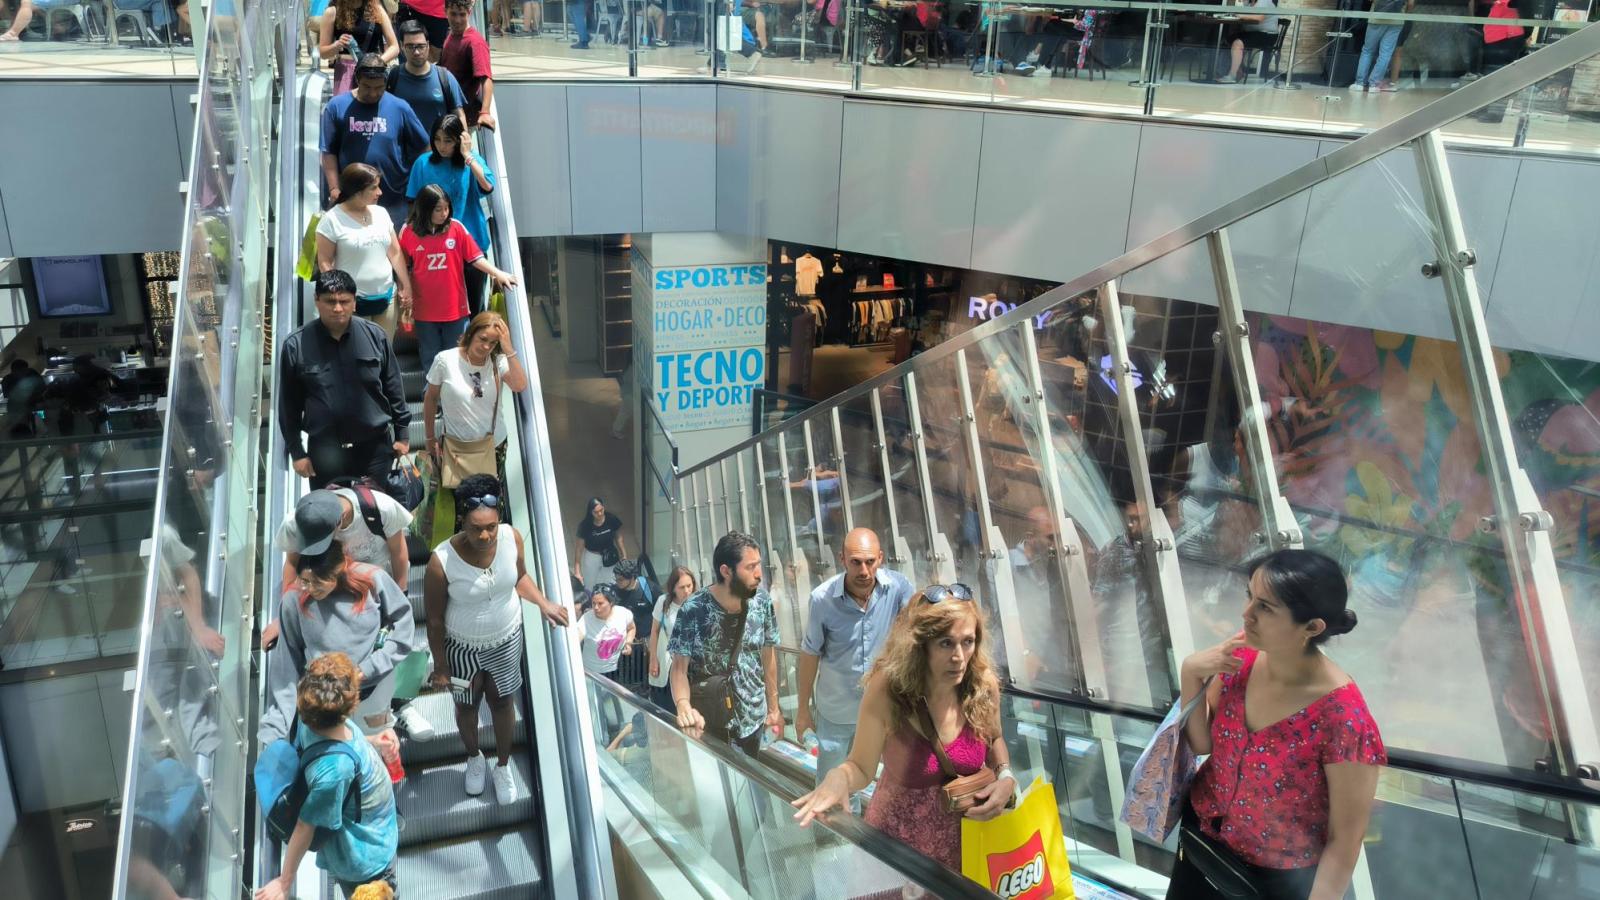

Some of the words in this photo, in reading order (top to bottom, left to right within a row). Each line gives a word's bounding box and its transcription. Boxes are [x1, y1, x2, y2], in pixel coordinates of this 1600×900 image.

[427, 253, 448, 271] 22
[655, 265, 766, 290] SPORTS
[656, 295, 722, 309] DECORACIÓN
[968, 296, 1053, 330] ROY
[655, 308, 713, 332] HOGAR
[724, 305, 766, 328] DECO
[656, 348, 763, 389] TECNO
[657, 392, 670, 412] Y
[678, 384, 763, 410] DEPORT
[997, 854, 1044, 898] LEGO
